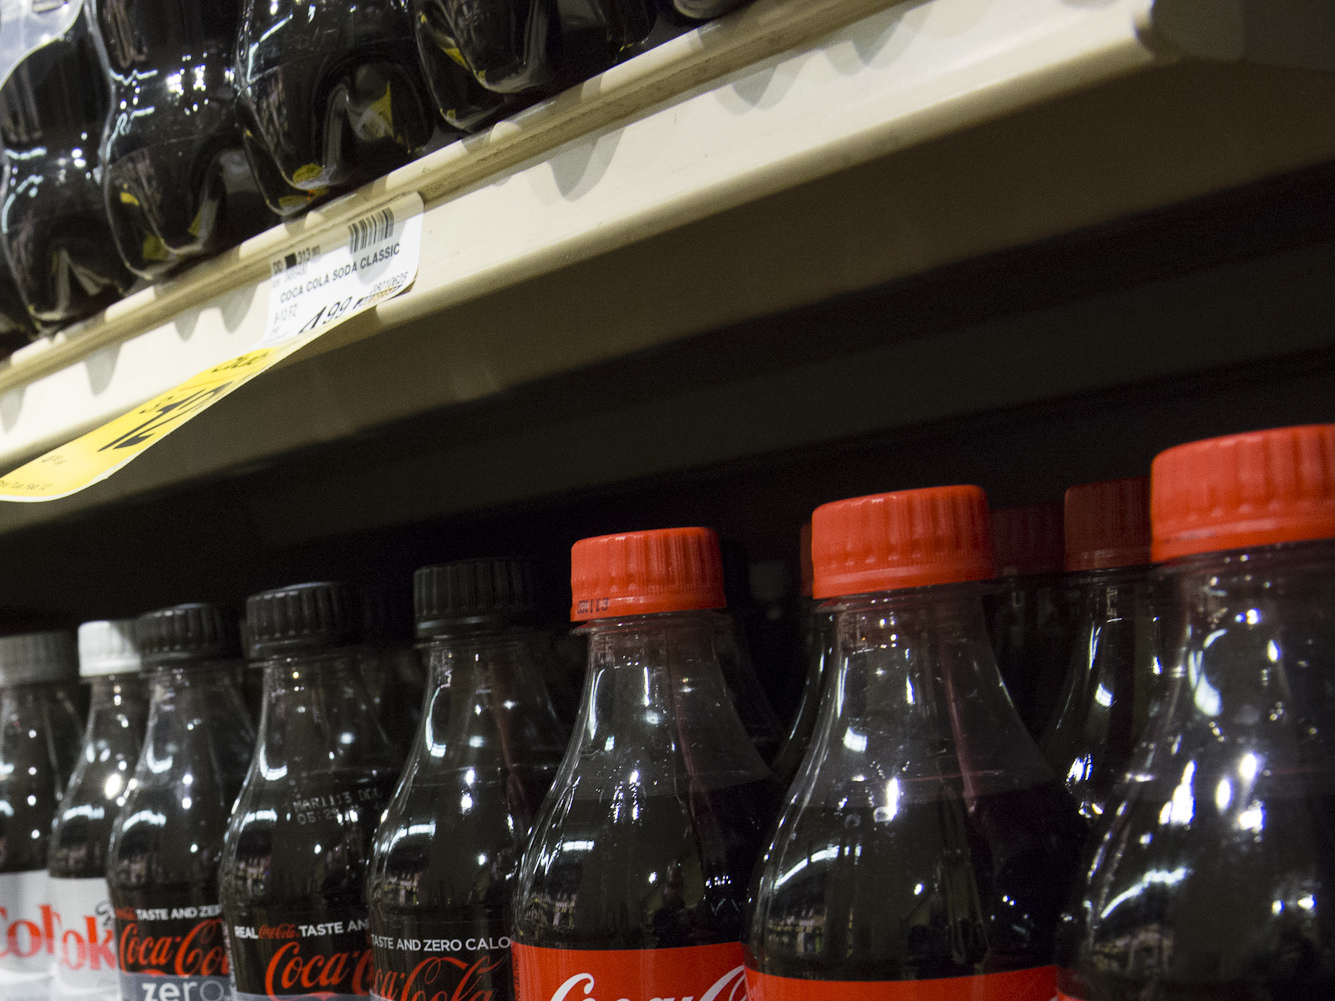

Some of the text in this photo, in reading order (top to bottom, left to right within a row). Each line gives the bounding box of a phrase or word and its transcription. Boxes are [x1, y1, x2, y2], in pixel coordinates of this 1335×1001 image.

[280, 285, 304, 303] COCA
[306, 274, 330, 292] COLA
[332, 262, 358, 281] SODA
[359, 243, 401, 269] CLASSIC
[136, 908, 168, 921] TASTE
[170, 906, 197, 919] AND
[234, 926, 258, 939] REAL
[298, 921, 344, 937] TASTE
[347, 918, 370, 933] AN
[119, 918, 230, 978] Coca-Co
[396, 938, 421, 951] AND
[423, 938, 463, 952] ZERO
[465, 936, 513, 950] CALO
